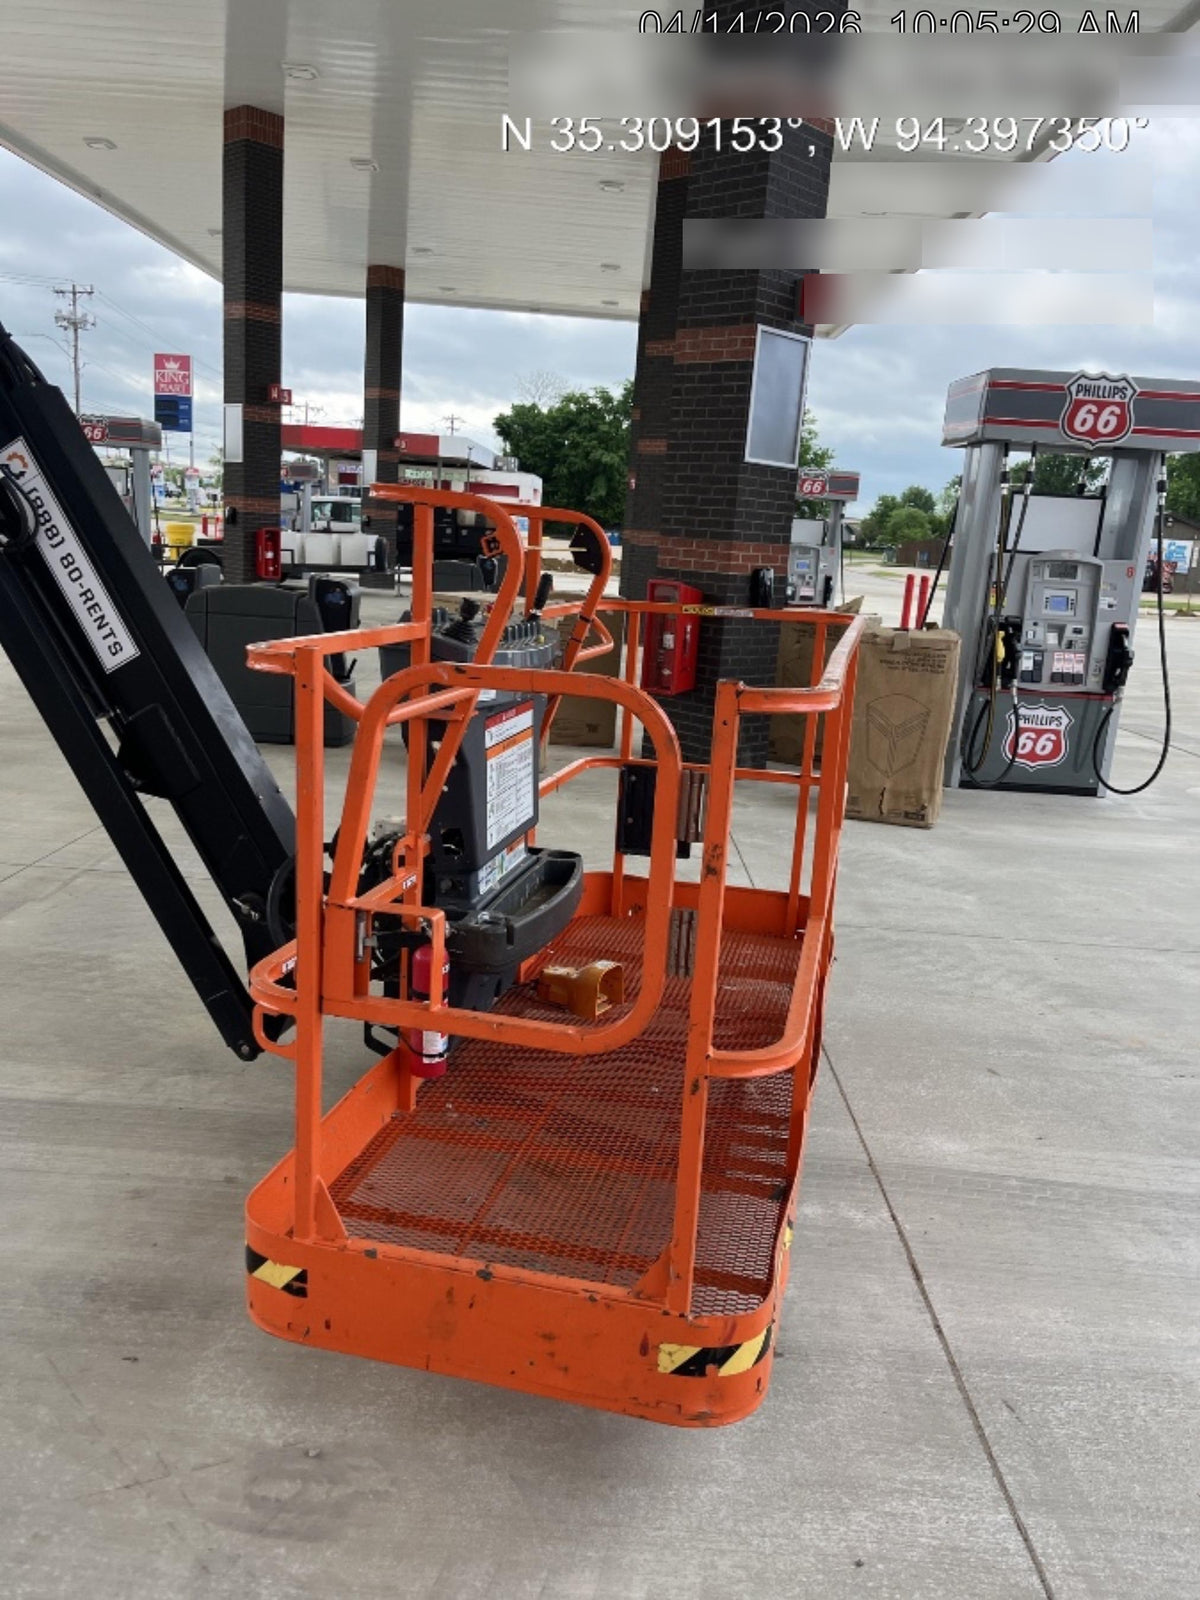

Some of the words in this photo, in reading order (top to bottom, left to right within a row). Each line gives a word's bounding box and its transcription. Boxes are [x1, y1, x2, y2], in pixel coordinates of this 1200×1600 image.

[156, 370, 189, 384] KING
[1075, 383, 1129, 400] PHILLIPS
[1073, 403, 1122, 434] 66
[802, 480, 823, 493] 66
[59, 552, 124, 657] 80-RENTS
[1017, 731, 1057, 756] 66
